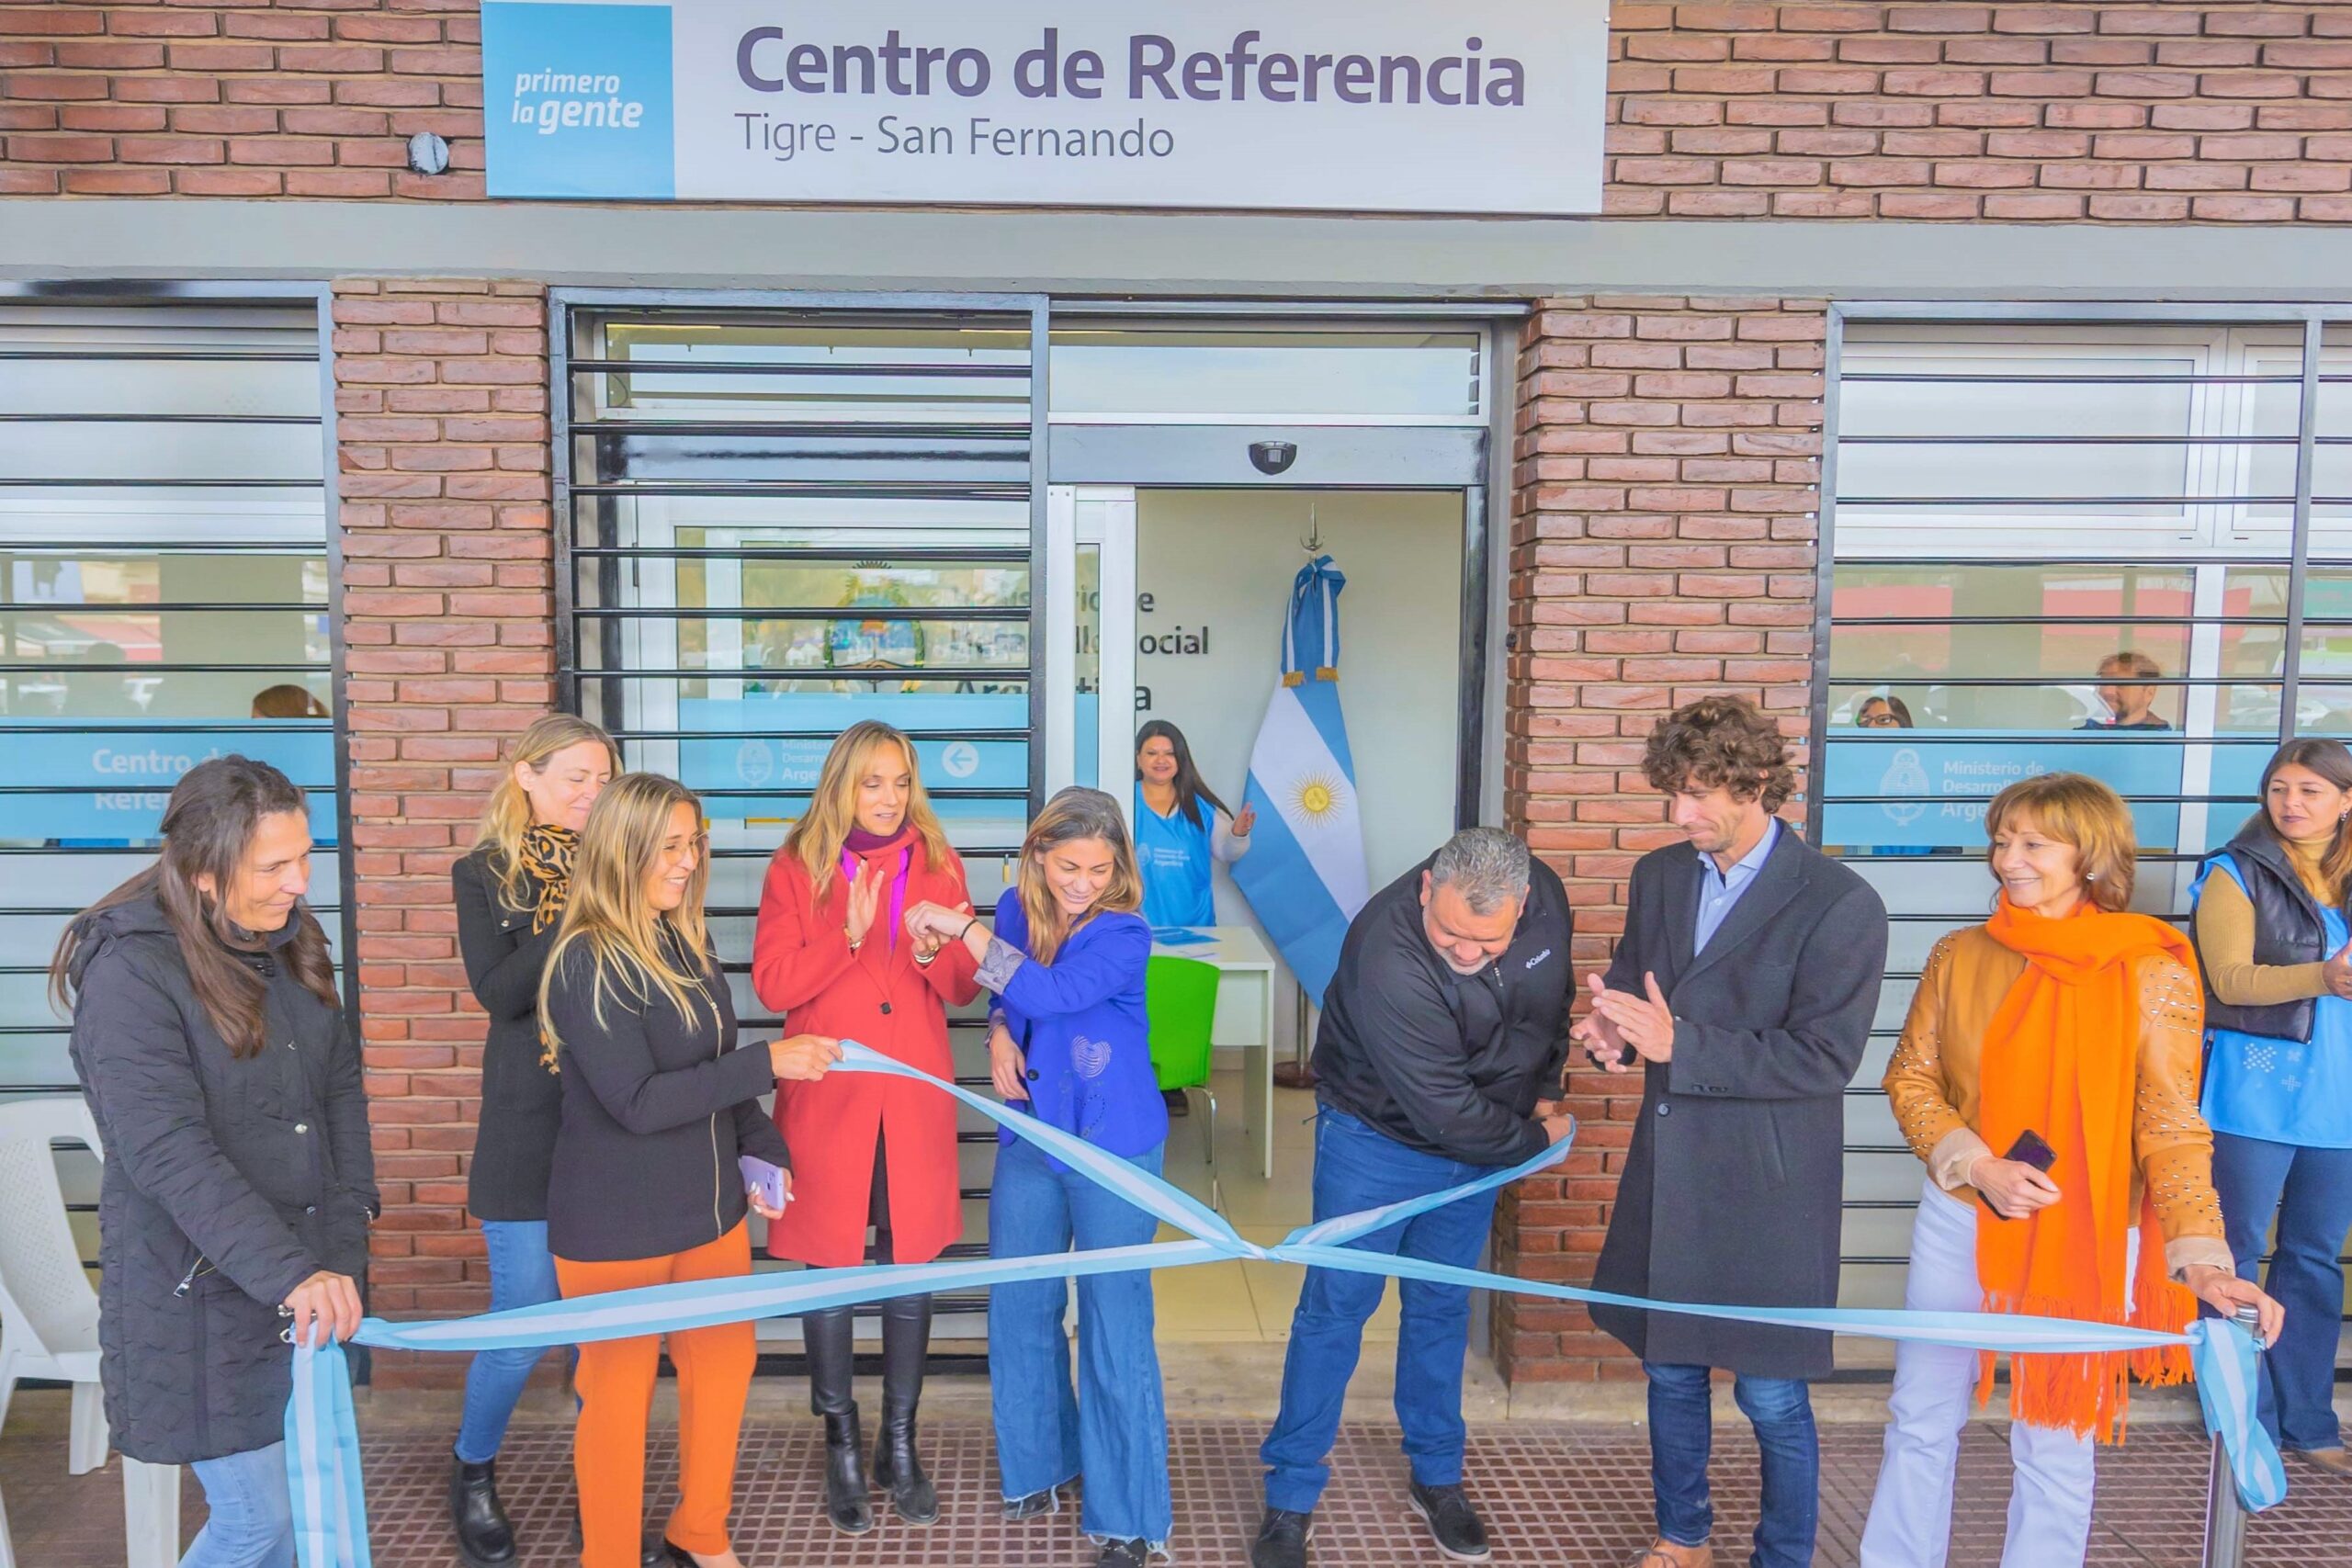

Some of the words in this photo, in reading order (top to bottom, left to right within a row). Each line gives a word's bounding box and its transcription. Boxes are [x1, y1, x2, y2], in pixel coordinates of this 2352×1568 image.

[737, 26, 991, 97] Centro
[1013, 28, 1104, 99] de
[1129, 30, 1525, 107] Referencia
[514, 67, 620, 97] primero
[512, 99, 535, 123] la
[538, 97, 643, 135] gente
[735, 112, 836, 162] Tigre
[877, 115, 953, 154] San
[970, 118, 1174, 158] Fernando
[1139, 626, 1209, 655] ocial
[93, 749, 191, 773] Centro
[1944, 761, 2020, 774] Ministerio
[2026, 761, 2044, 775] de
